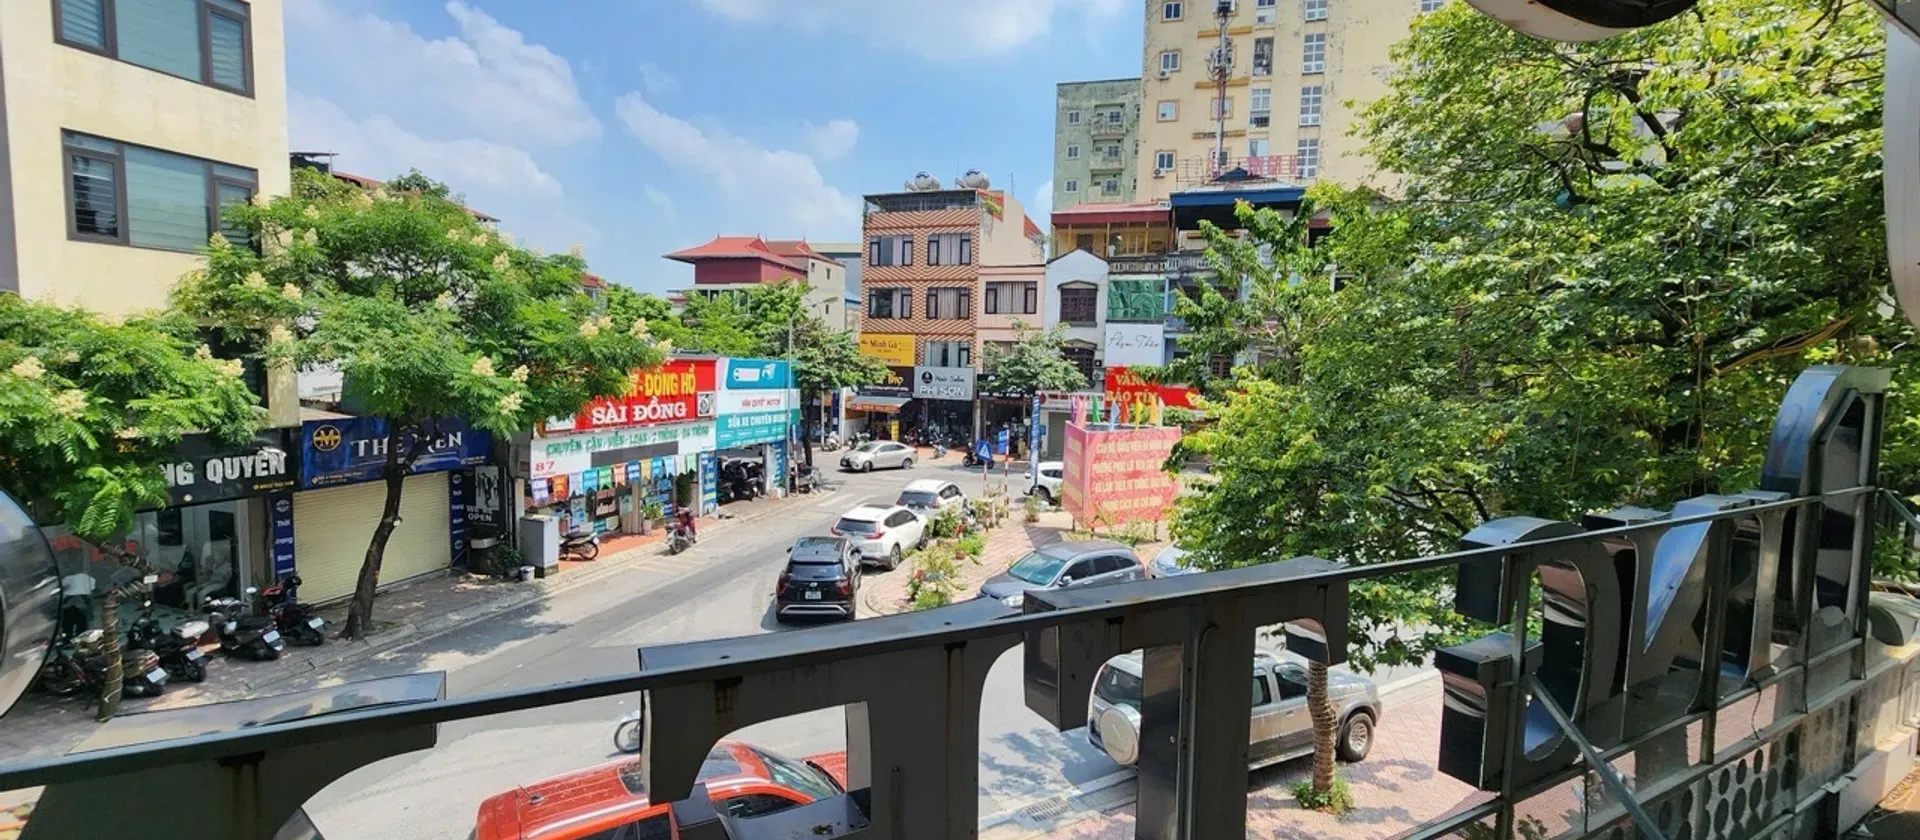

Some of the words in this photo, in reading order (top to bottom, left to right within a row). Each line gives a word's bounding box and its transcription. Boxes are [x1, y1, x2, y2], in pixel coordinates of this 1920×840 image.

[591, 402, 628, 425] SÀI
[633, 395, 687, 421] ĐỒNG
[535, 460, 555, 472] 87
